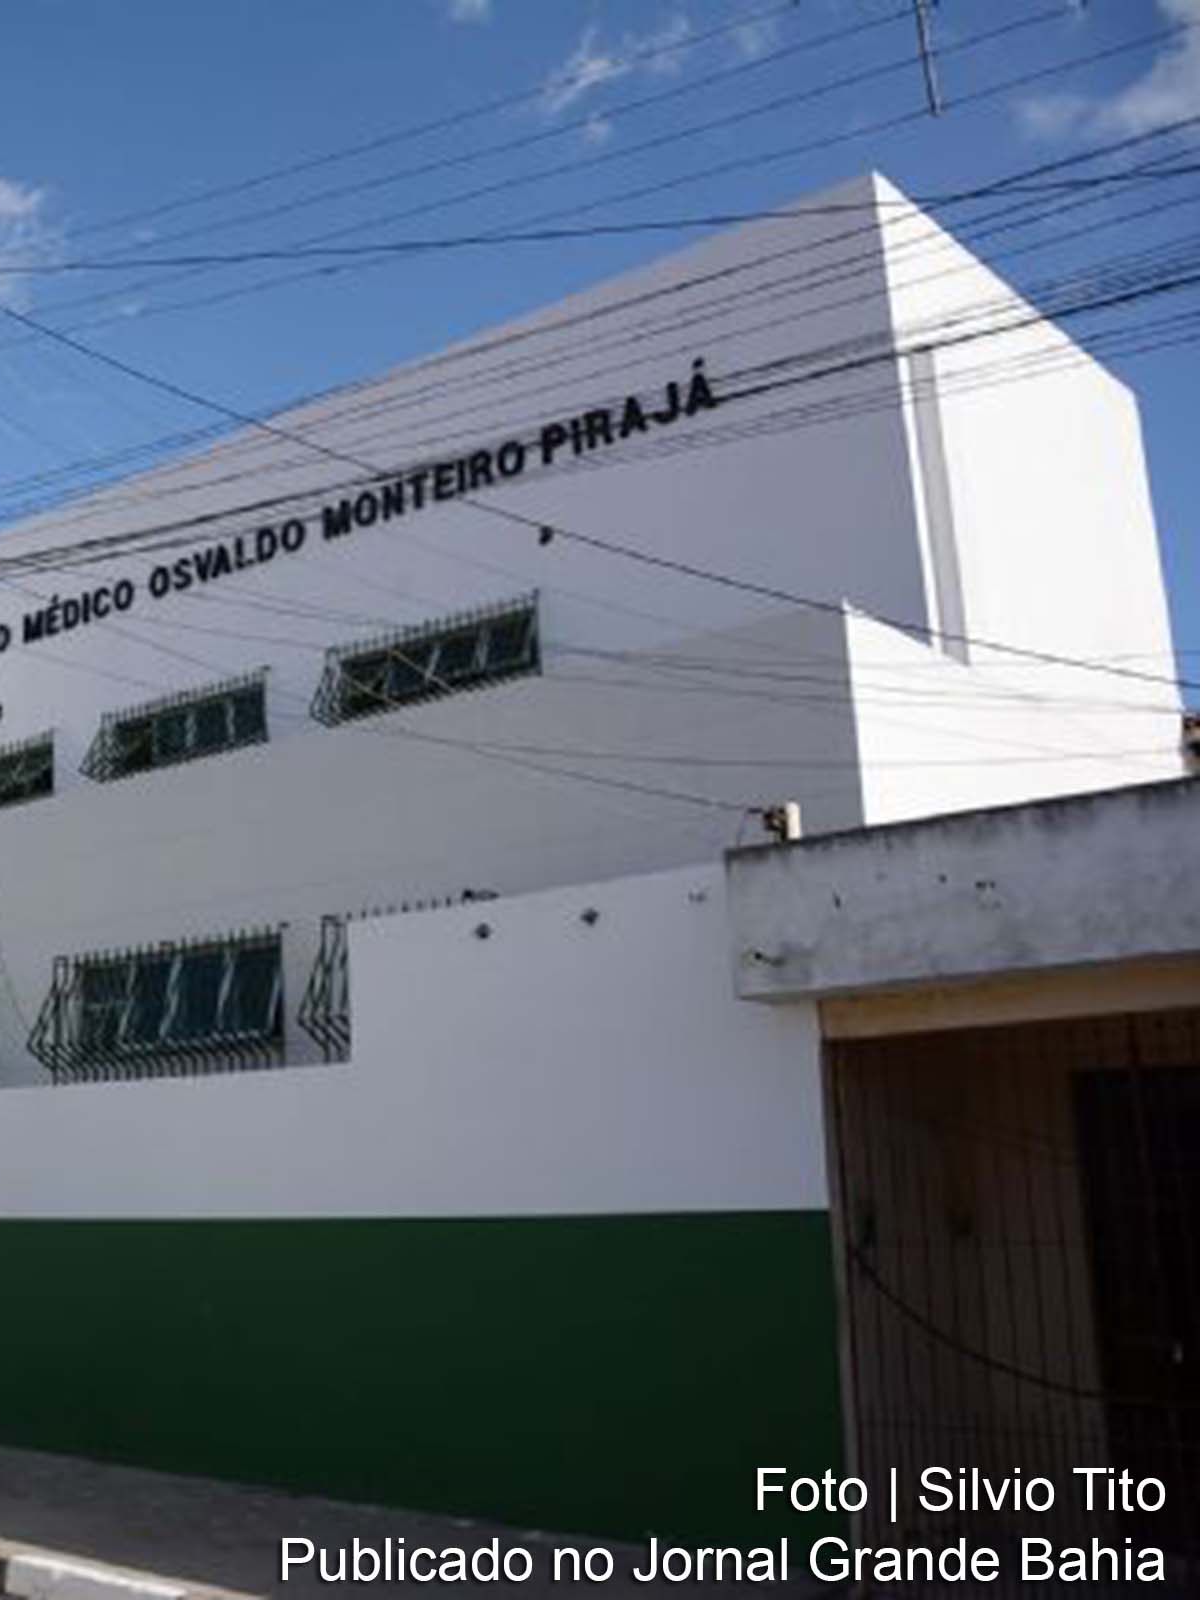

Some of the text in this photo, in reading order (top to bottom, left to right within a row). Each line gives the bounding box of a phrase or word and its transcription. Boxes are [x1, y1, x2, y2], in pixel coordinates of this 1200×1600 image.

[22, 578, 135, 644] MÉDICO
[148, 518, 307, 599] OSVALDO
[321, 442, 526, 541] MONTEIRO
[540, 356, 718, 465] PIRAJÁ
